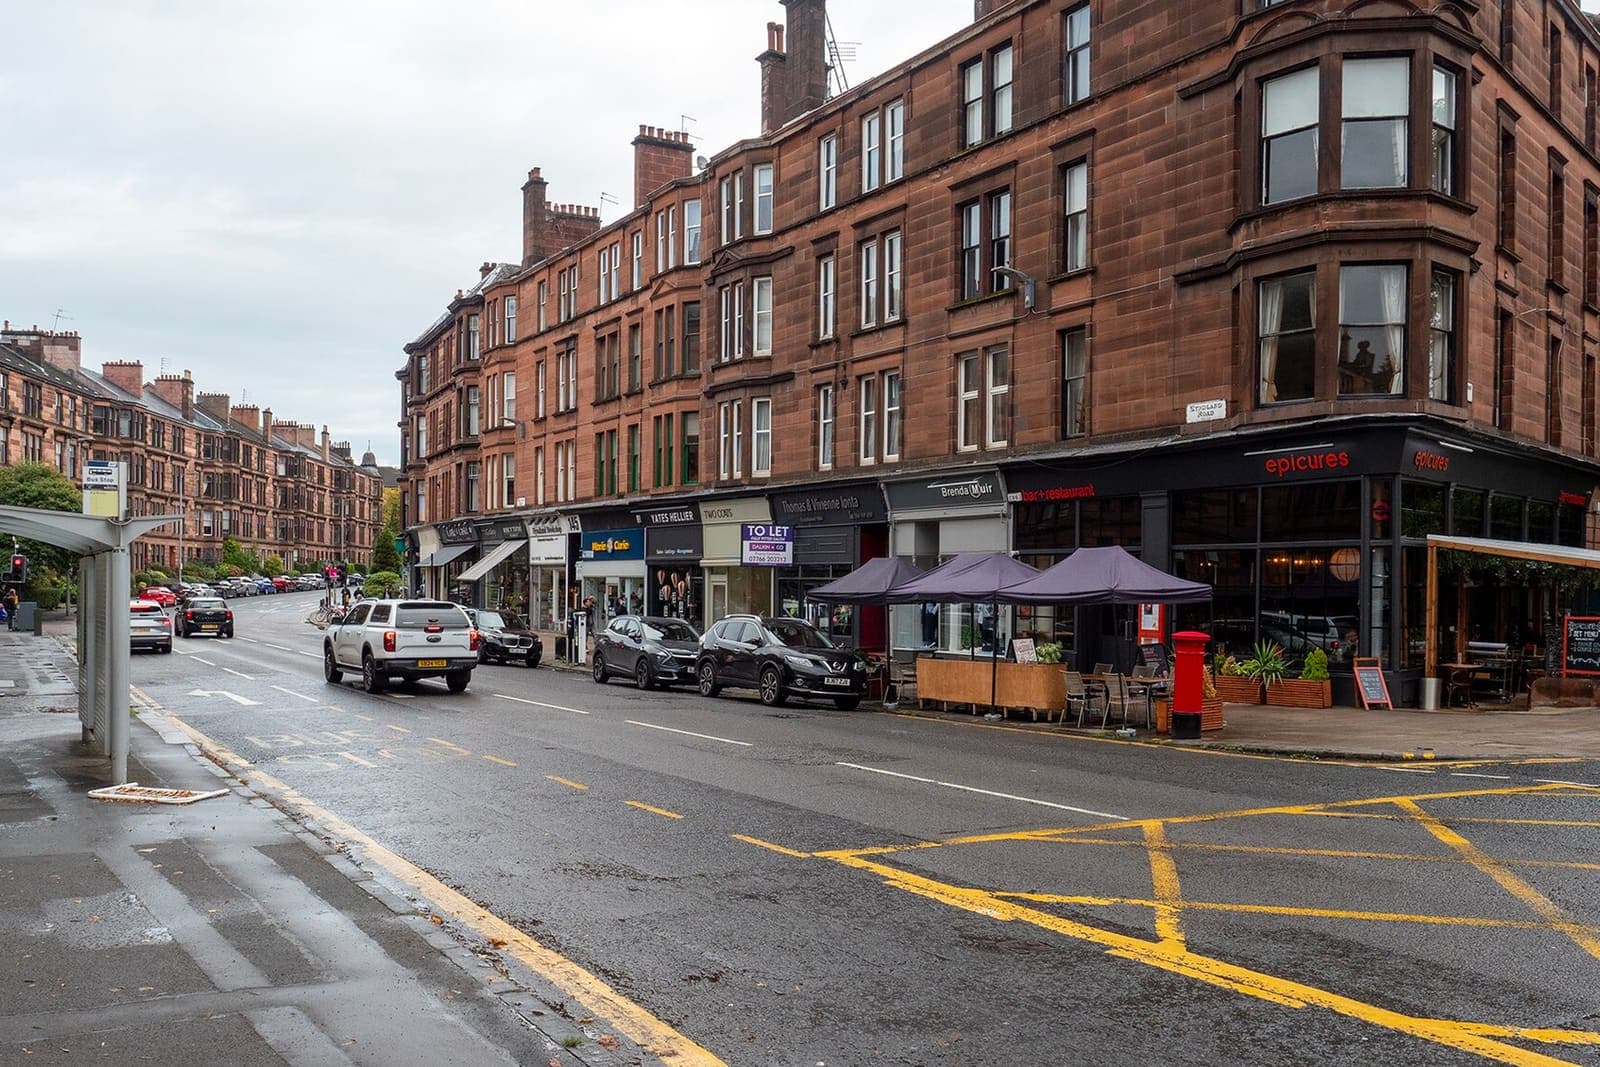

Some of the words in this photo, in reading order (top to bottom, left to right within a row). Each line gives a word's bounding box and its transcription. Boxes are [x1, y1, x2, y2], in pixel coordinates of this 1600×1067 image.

[1197, 410, 1215, 418] ROAD
[1265, 451, 1349, 477] epicures
[1415, 450, 1449, 472] epicures
[941, 486, 969, 497] Brenda
[969, 484, 993, 498] Muir
[781, 500, 806, 513] Thomas
[651, 513, 669, 524] YATES
[669, 511, 694, 522] HELLIER
[704, 509, 716, 519] TWO
[716, 508, 733, 519] COATS
[747, 525, 765, 536] TO
[769, 526, 789, 537] LET
